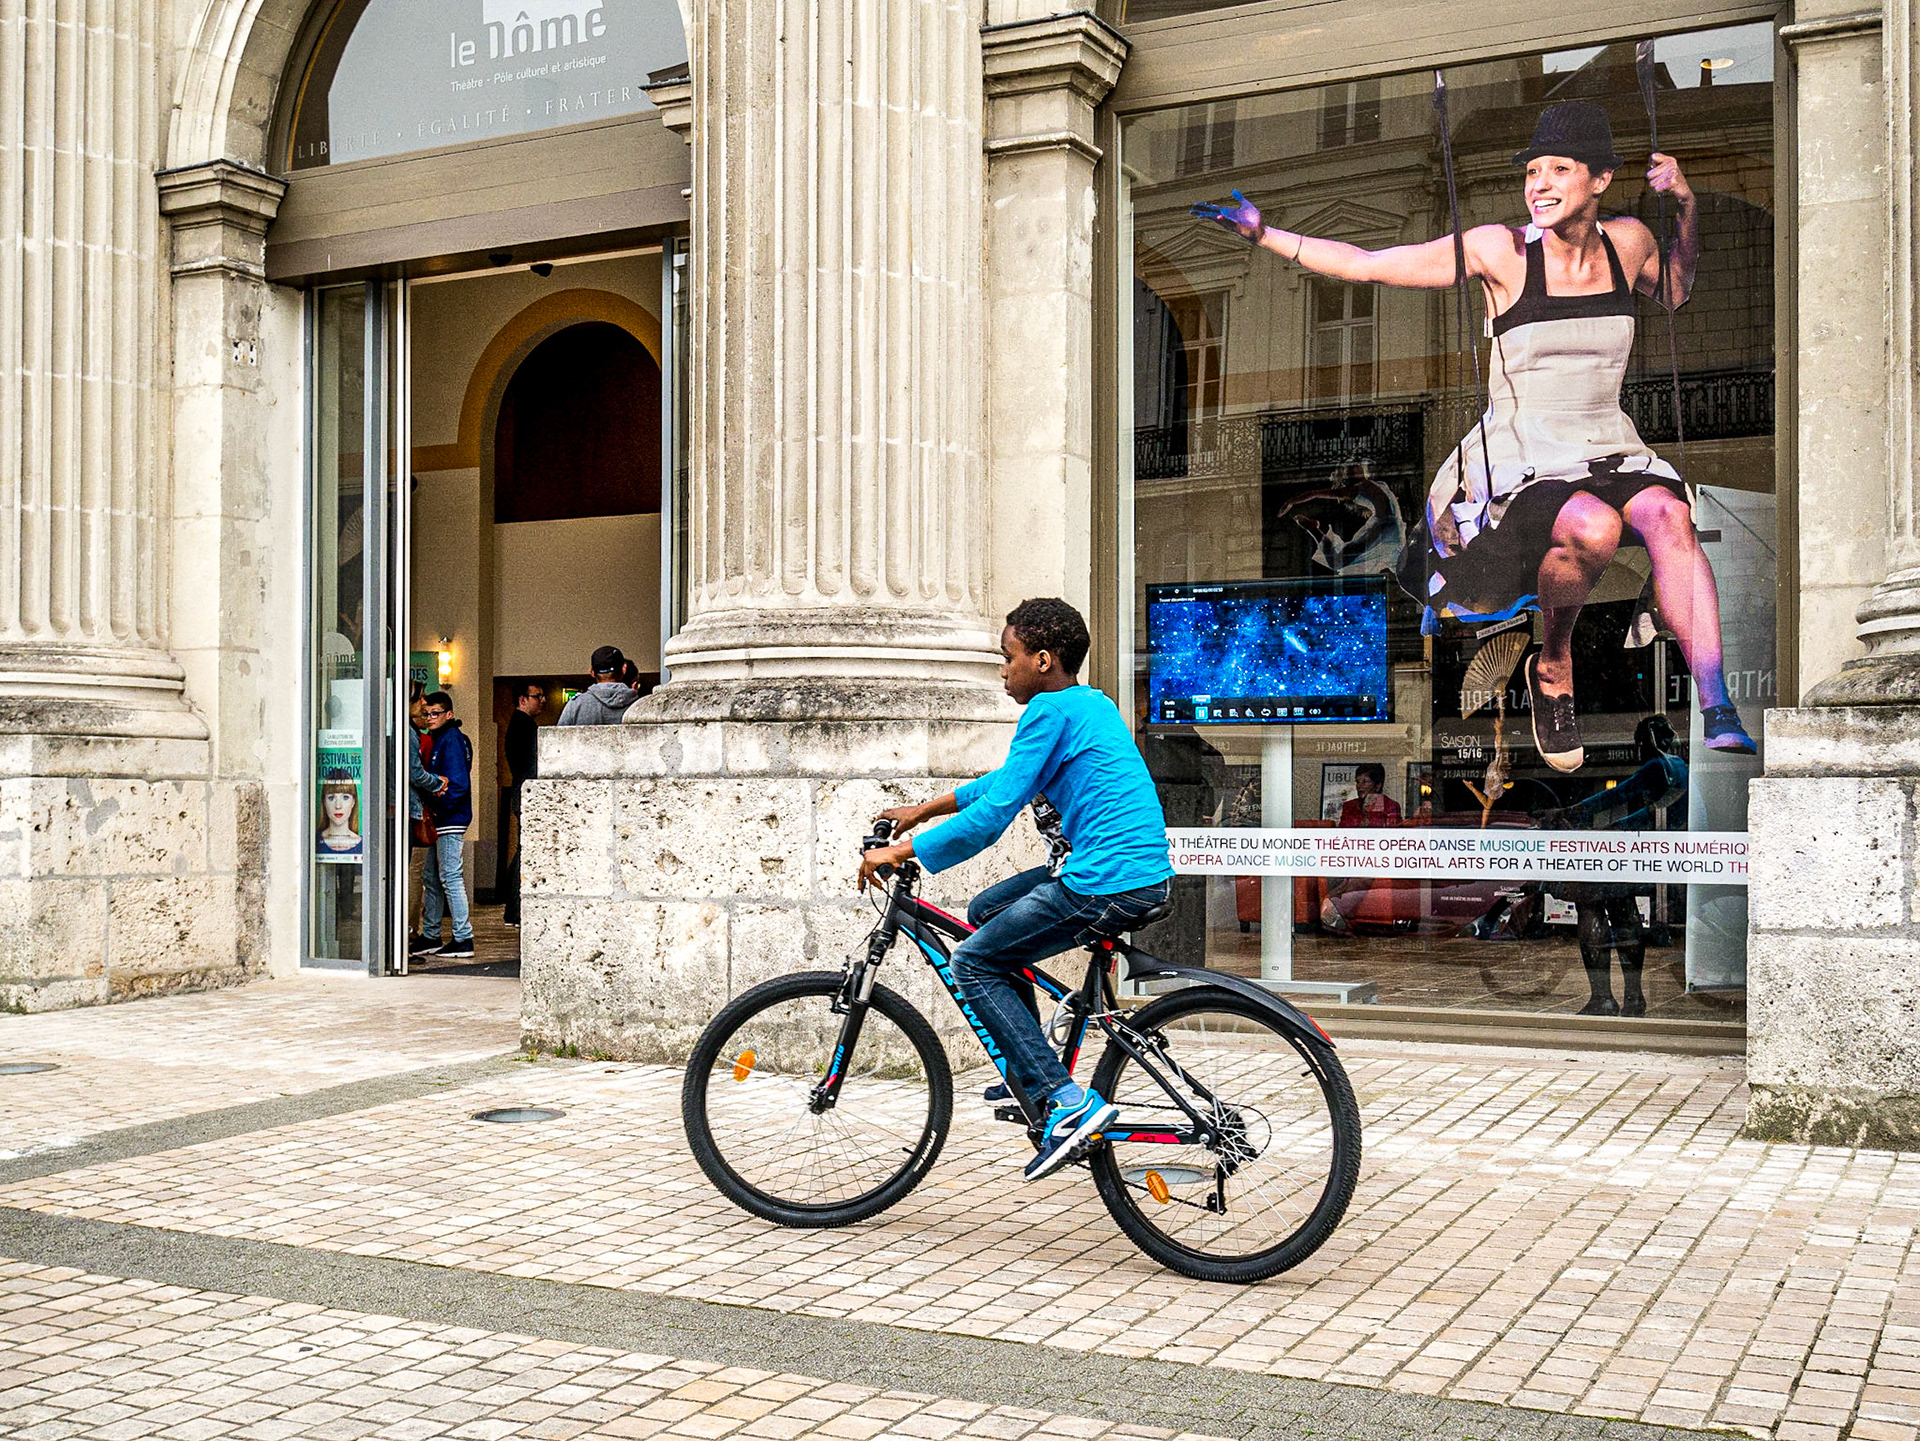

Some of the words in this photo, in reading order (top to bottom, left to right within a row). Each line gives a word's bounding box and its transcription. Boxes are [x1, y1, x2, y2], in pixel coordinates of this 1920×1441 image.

[450, 32, 476, 68] le
[451, 78, 484, 93] Théâtre
[494, 71, 514, 84] Pôle
[516, 64, 549, 80] culturel
[551, 61, 562, 73] et
[564, 54, 607, 71] artistique
[418, 103, 509, 138] ÉGALITÉ
[1440, 736, 1481, 749] SAISON
[317, 752, 350, 765] FESTIVAL
[351, 755, 361, 765] DES
[1457, 748, 1483, 759] 15/16
[1327, 772, 1352, 783] UBU
[1180, 835, 1237, 849] THÉÂTRE
[1240, 838, 1259, 849] DU
[1262, 838, 1311, 850] MONDE
[1315, 836, 1375, 850] THÉÂTRE
[1379, 837, 1426, 851] OPÉRA
[1430, 839, 1476, 851] DANSE
[1480, 840, 1546, 852] MUSIQUE
[1550, 840, 1626, 854] FESTIVALS
[1630, 841, 1670, 854] ARTS
[1674, 840, 1748, 855] NUMÉRIQ
[1179, 854, 1223, 865] OPERA
[1227, 855, 1271, 866] DANCE
[1274, 855, 1317, 866] MUSIC
[1320, 856, 1390, 868] FESTIVALS
[1394, 857, 1444, 868] DIGITAL
[1448, 857, 1485, 869] ARTS
[1489, 858, 1519, 869] FOR
[1523, 858, 1533, 869] A
[1537, 858, 1603, 870] THEATER
[1607, 859, 1629, 871] OF
[1633, 860, 1662, 872] THE
[1667, 861, 1723, 873] WORLD
